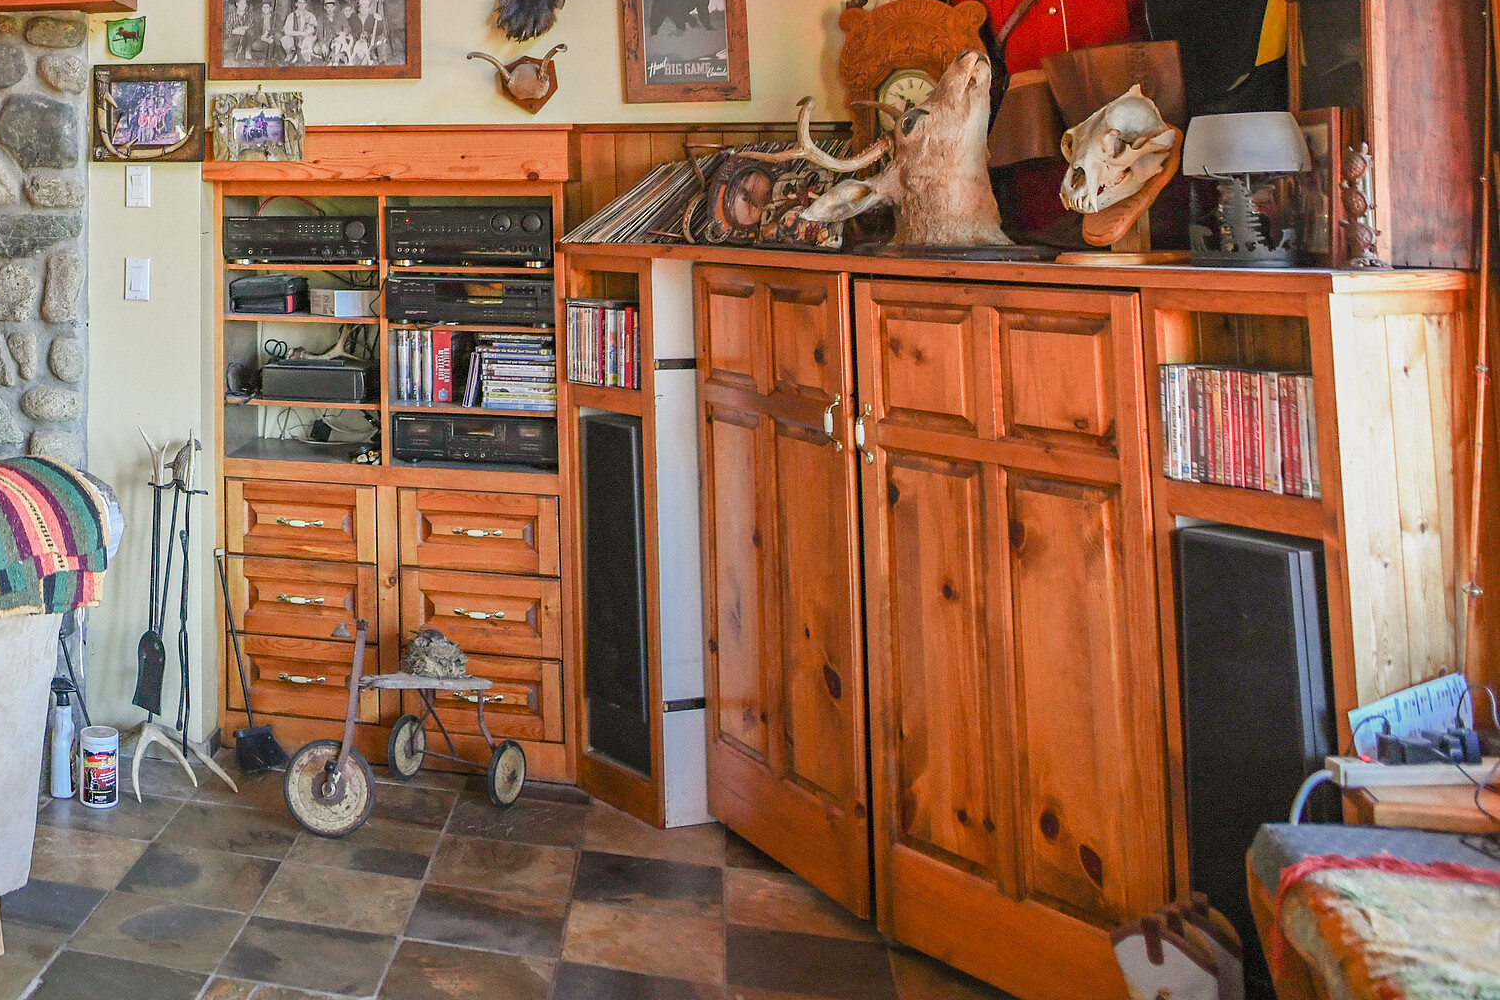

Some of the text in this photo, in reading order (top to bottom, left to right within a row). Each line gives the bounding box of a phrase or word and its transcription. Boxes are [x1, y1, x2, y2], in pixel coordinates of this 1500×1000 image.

[648, 57, 667, 78] Hunt
[665, 63, 682, 76] BIG
[684, 62, 711, 75] GAME
